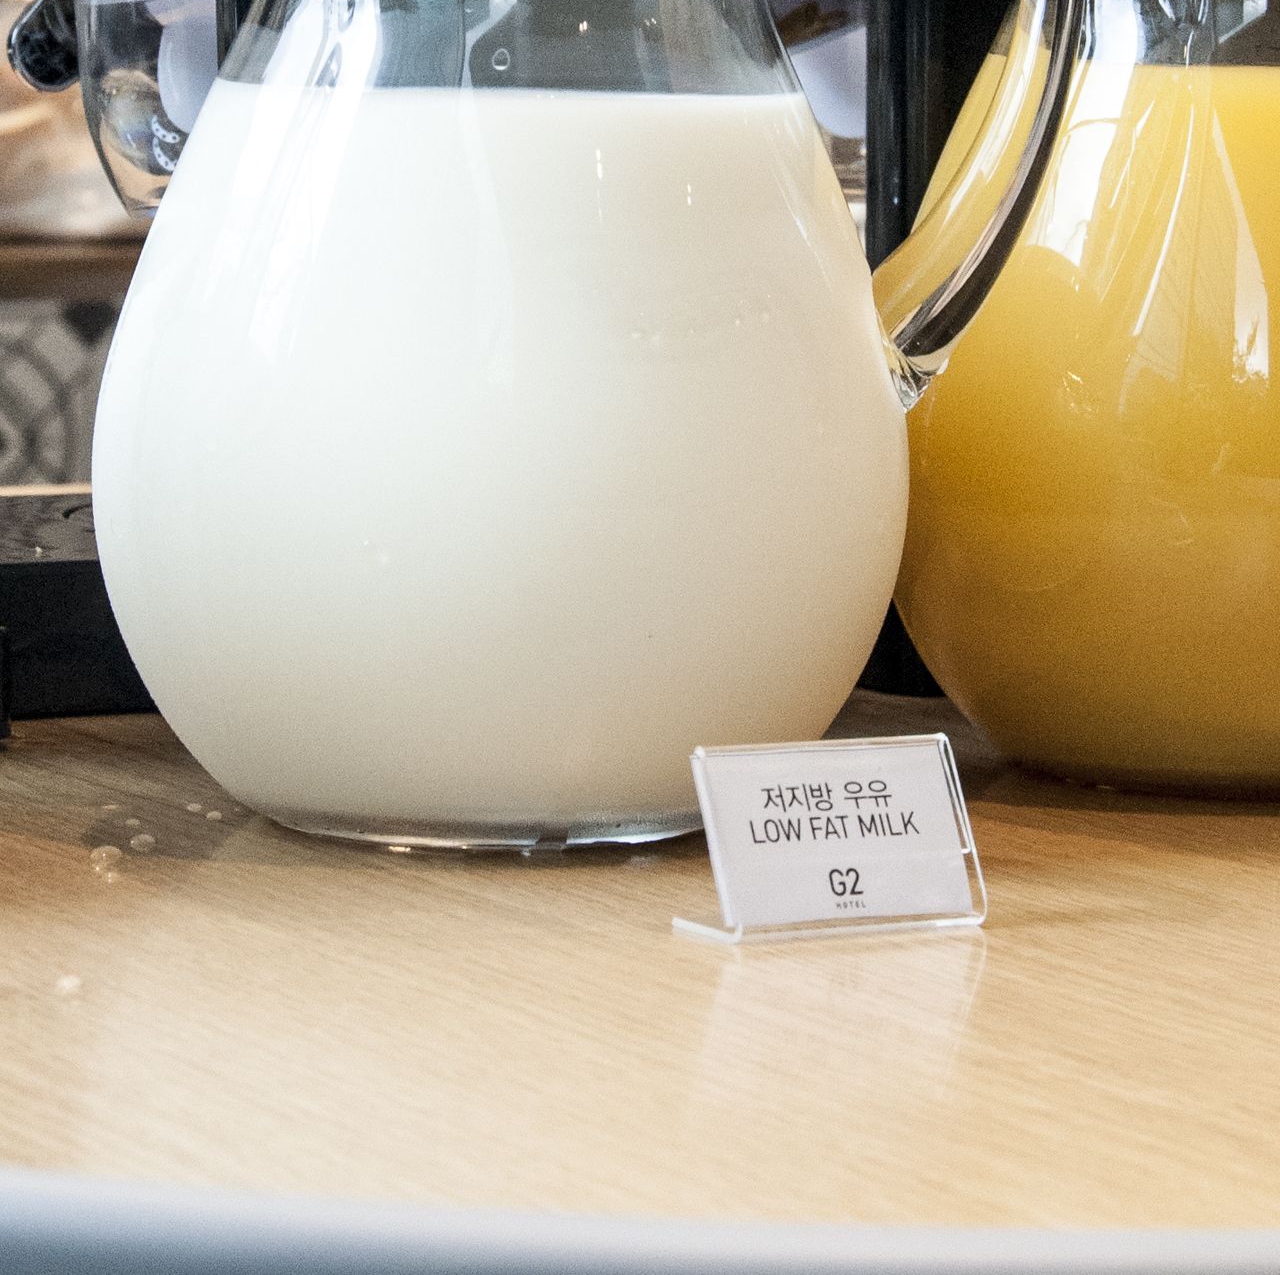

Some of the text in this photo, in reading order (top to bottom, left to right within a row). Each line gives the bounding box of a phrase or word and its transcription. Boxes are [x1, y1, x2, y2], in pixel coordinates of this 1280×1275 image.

[761, 780, 892, 812] 저지방 우유
[749, 811, 920, 844] LOW FAT MILK
[829, 868, 864, 897] G2
[835, 901, 867, 909] HOTEL
